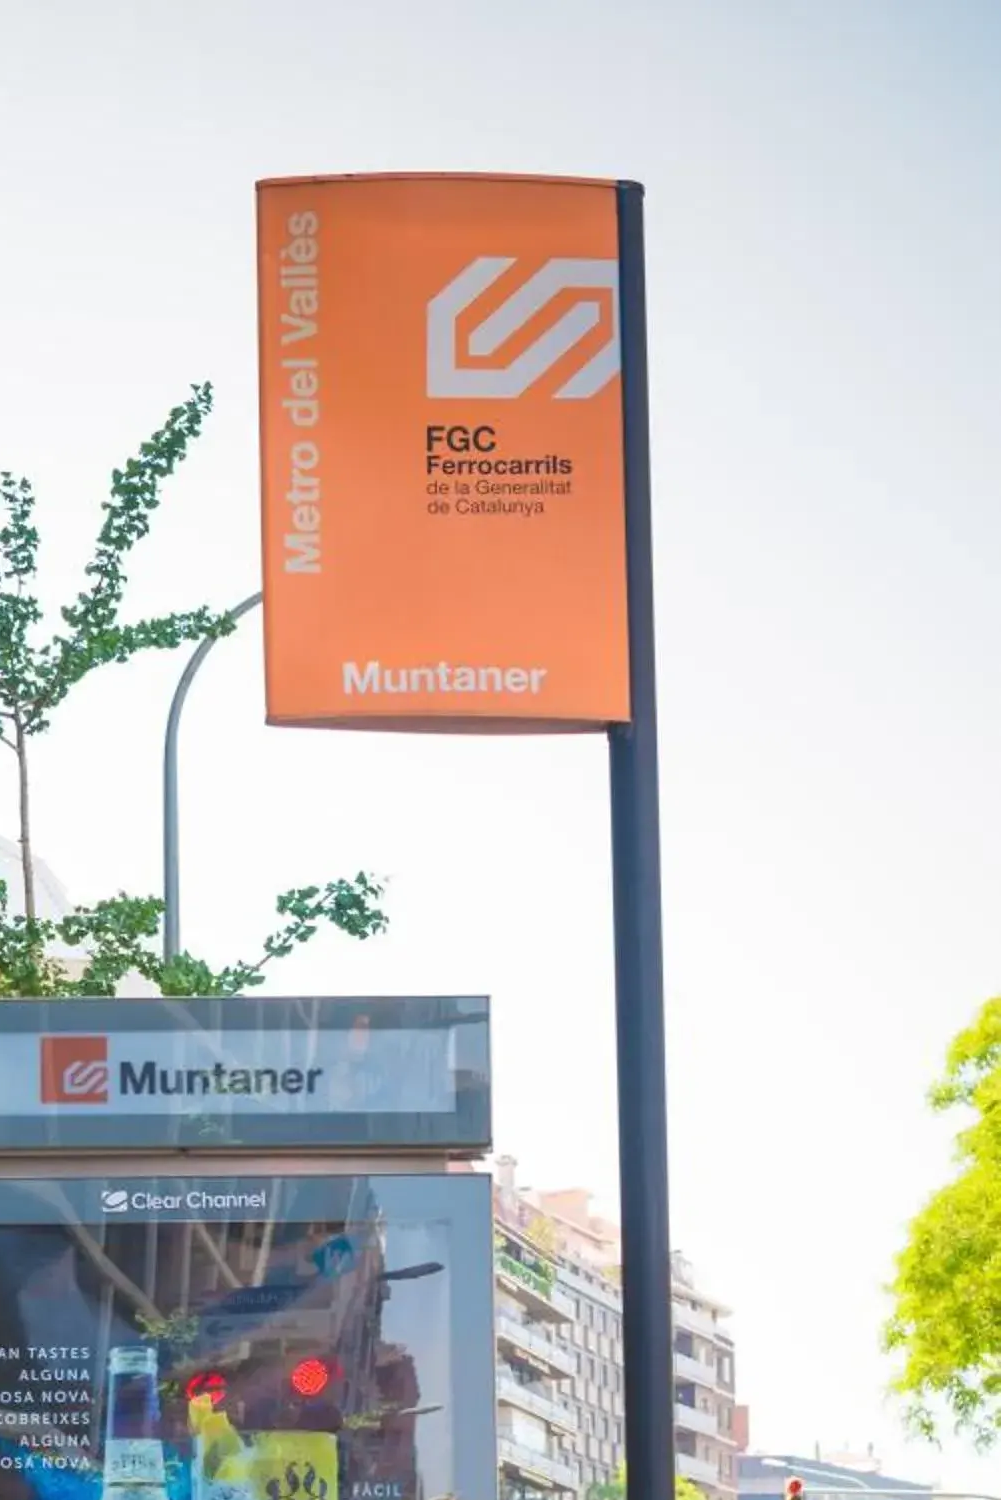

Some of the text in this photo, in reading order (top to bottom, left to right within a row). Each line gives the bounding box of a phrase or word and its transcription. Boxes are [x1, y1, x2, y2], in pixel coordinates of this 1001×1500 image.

[280, 210, 322, 573] Metro del Vallès
[426, 424, 497, 452] FGC
[426, 454, 573, 475] Ferrocarrils
[426, 479, 573, 495] de la Generalitat
[427, 498, 545, 517] de Catalunya
[341, 660, 548, 695] Muntaner
[119, 1061, 324, 1096] Muntaner
[131, 1189, 267, 1210] Clear Channel
[27, 1347, 91, 1359] TASTES
[19, 1369, 91, 1381] ALGUNA
[19, 1434, 91, 1447] ALGUNA
[42, 1456, 91, 1469] NOVA
